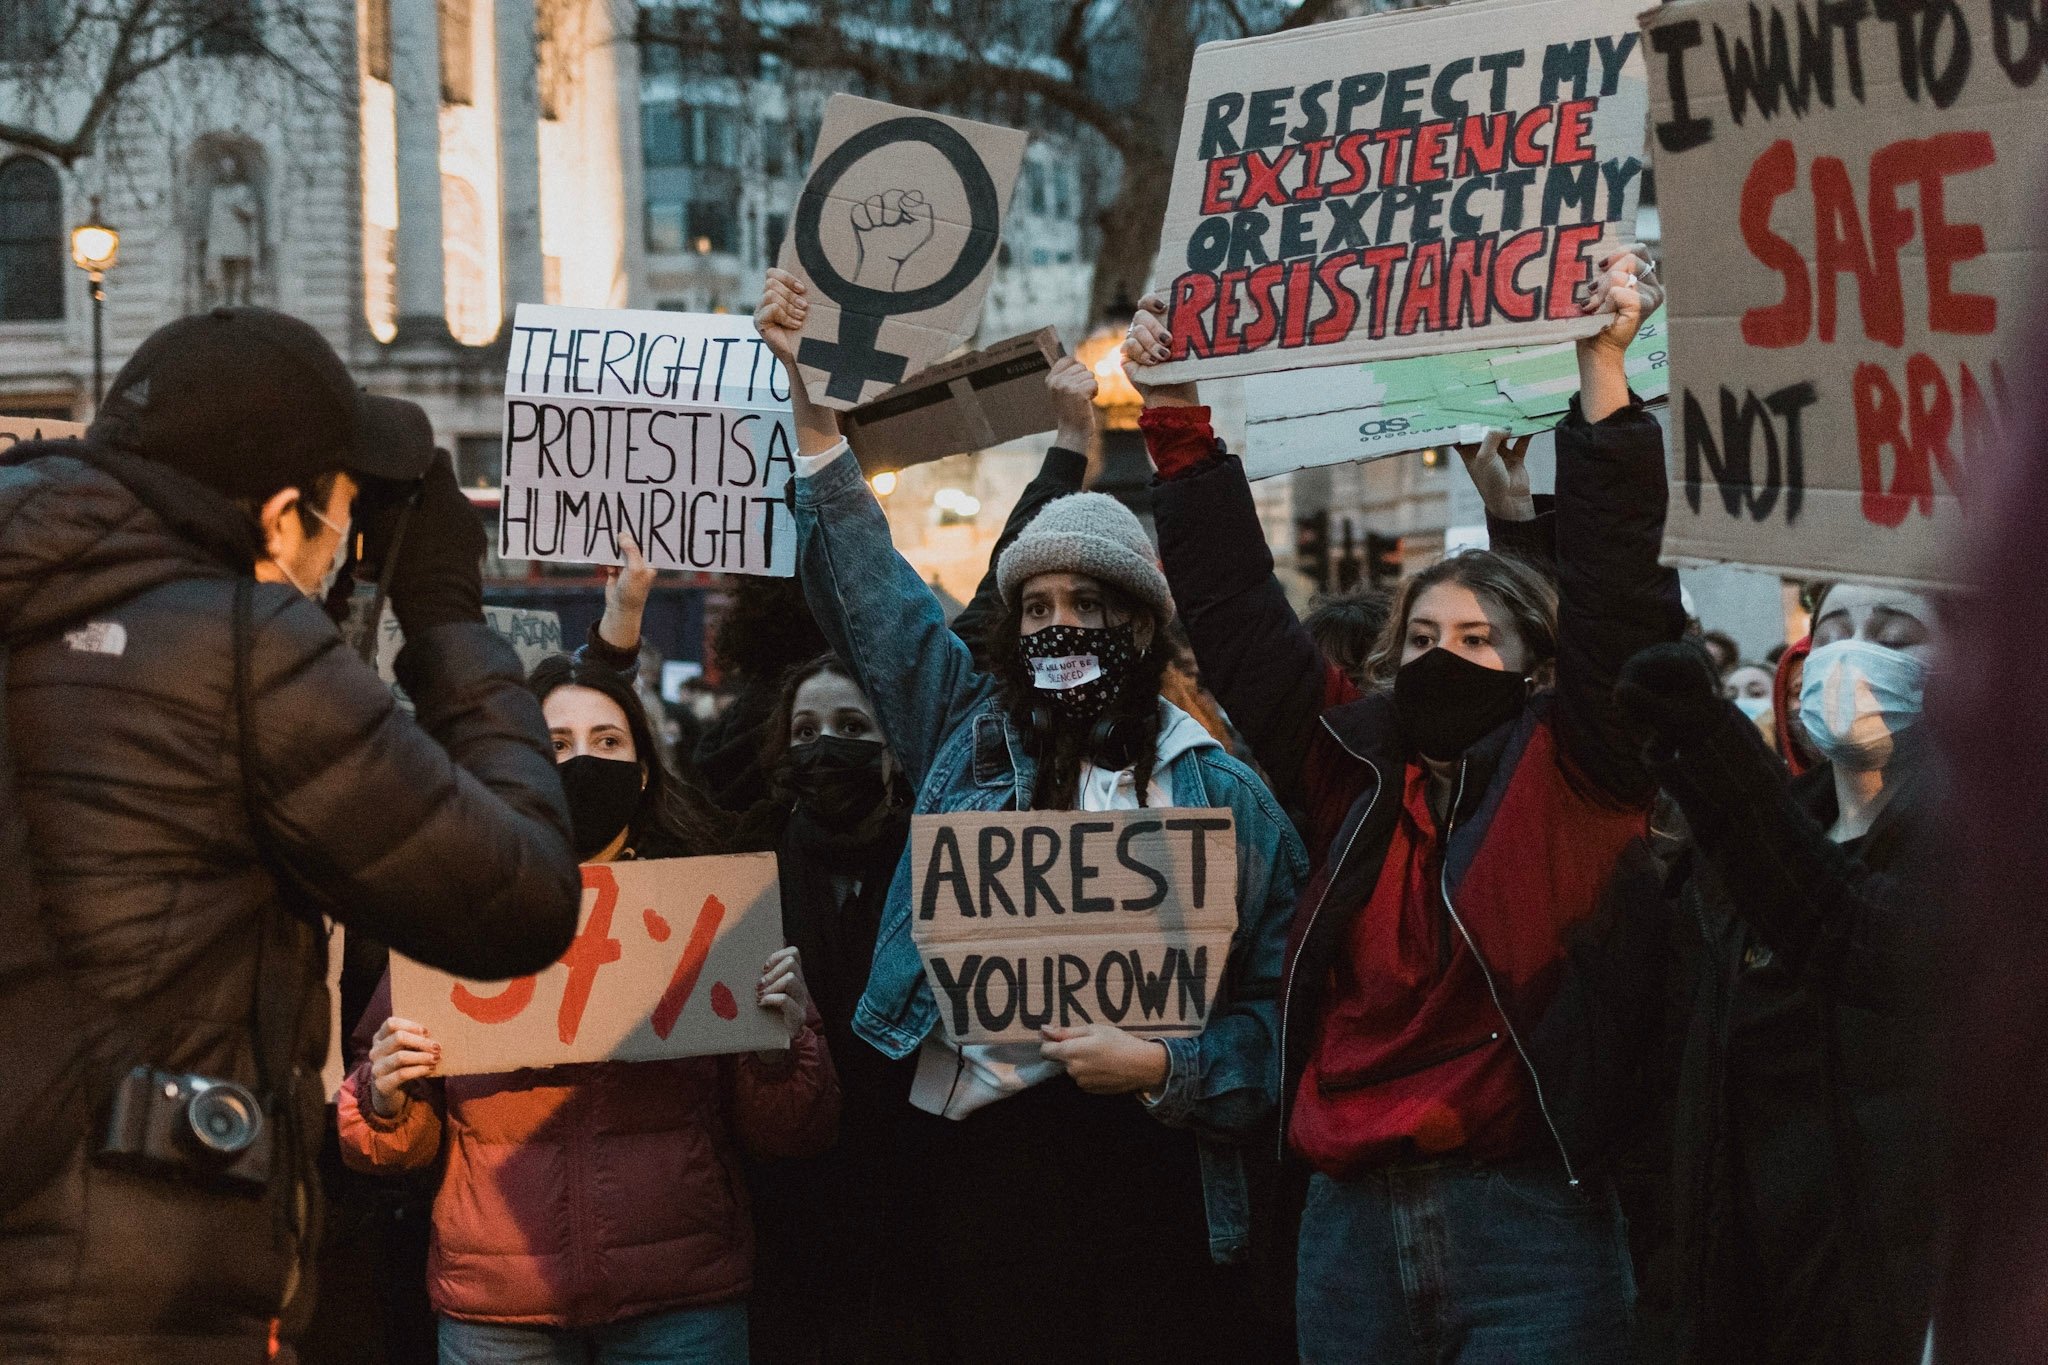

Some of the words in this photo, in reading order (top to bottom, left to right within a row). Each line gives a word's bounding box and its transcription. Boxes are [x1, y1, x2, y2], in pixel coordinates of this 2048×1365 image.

[1199, 48, 1525, 160] RESPECT
[1538, 31, 1641, 106] MY
[1650, 18, 1713, 153] I
[1712, 0, 1870, 127] WANT
[1873, 0, 1972, 109] TO
[1200, 97, 1598, 216] EXISTENCE
[1187, 210, 1270, 274] OR
[1280, 166, 1536, 259] EXPECT
[1540, 156, 1642, 227] MY
[1738, 130, 1997, 349] SAFE
[1167, 221, 1606, 362] RESISTANCE
[515, 326, 600, 394] THE
[598, 330, 740, 402] RIGHT
[747, 337, 792, 402] TO
[506, 400, 712, 486] PROTEST
[717, 412, 762, 488] IS
[762, 419, 797, 488] A
[1359, 414, 1425, 436] as
[1682, 380, 1820, 527] NOT
[502, 483, 644, 560] HUMAN
[648, 488, 790, 569] RIGHT
[1035, 662, 1044, 672] WE
[1046, 663, 1059, 671] WILL
[1060, 660, 1077, 670] NOT
[1080, 659, 1092, 668] BE
[1047, 670, 1084, 684] SILENCED
[919, 818, 1232, 920] ARREST
[929, 950, 1094, 1036] YOUR
[1095, 945, 1208, 1024] OWN
